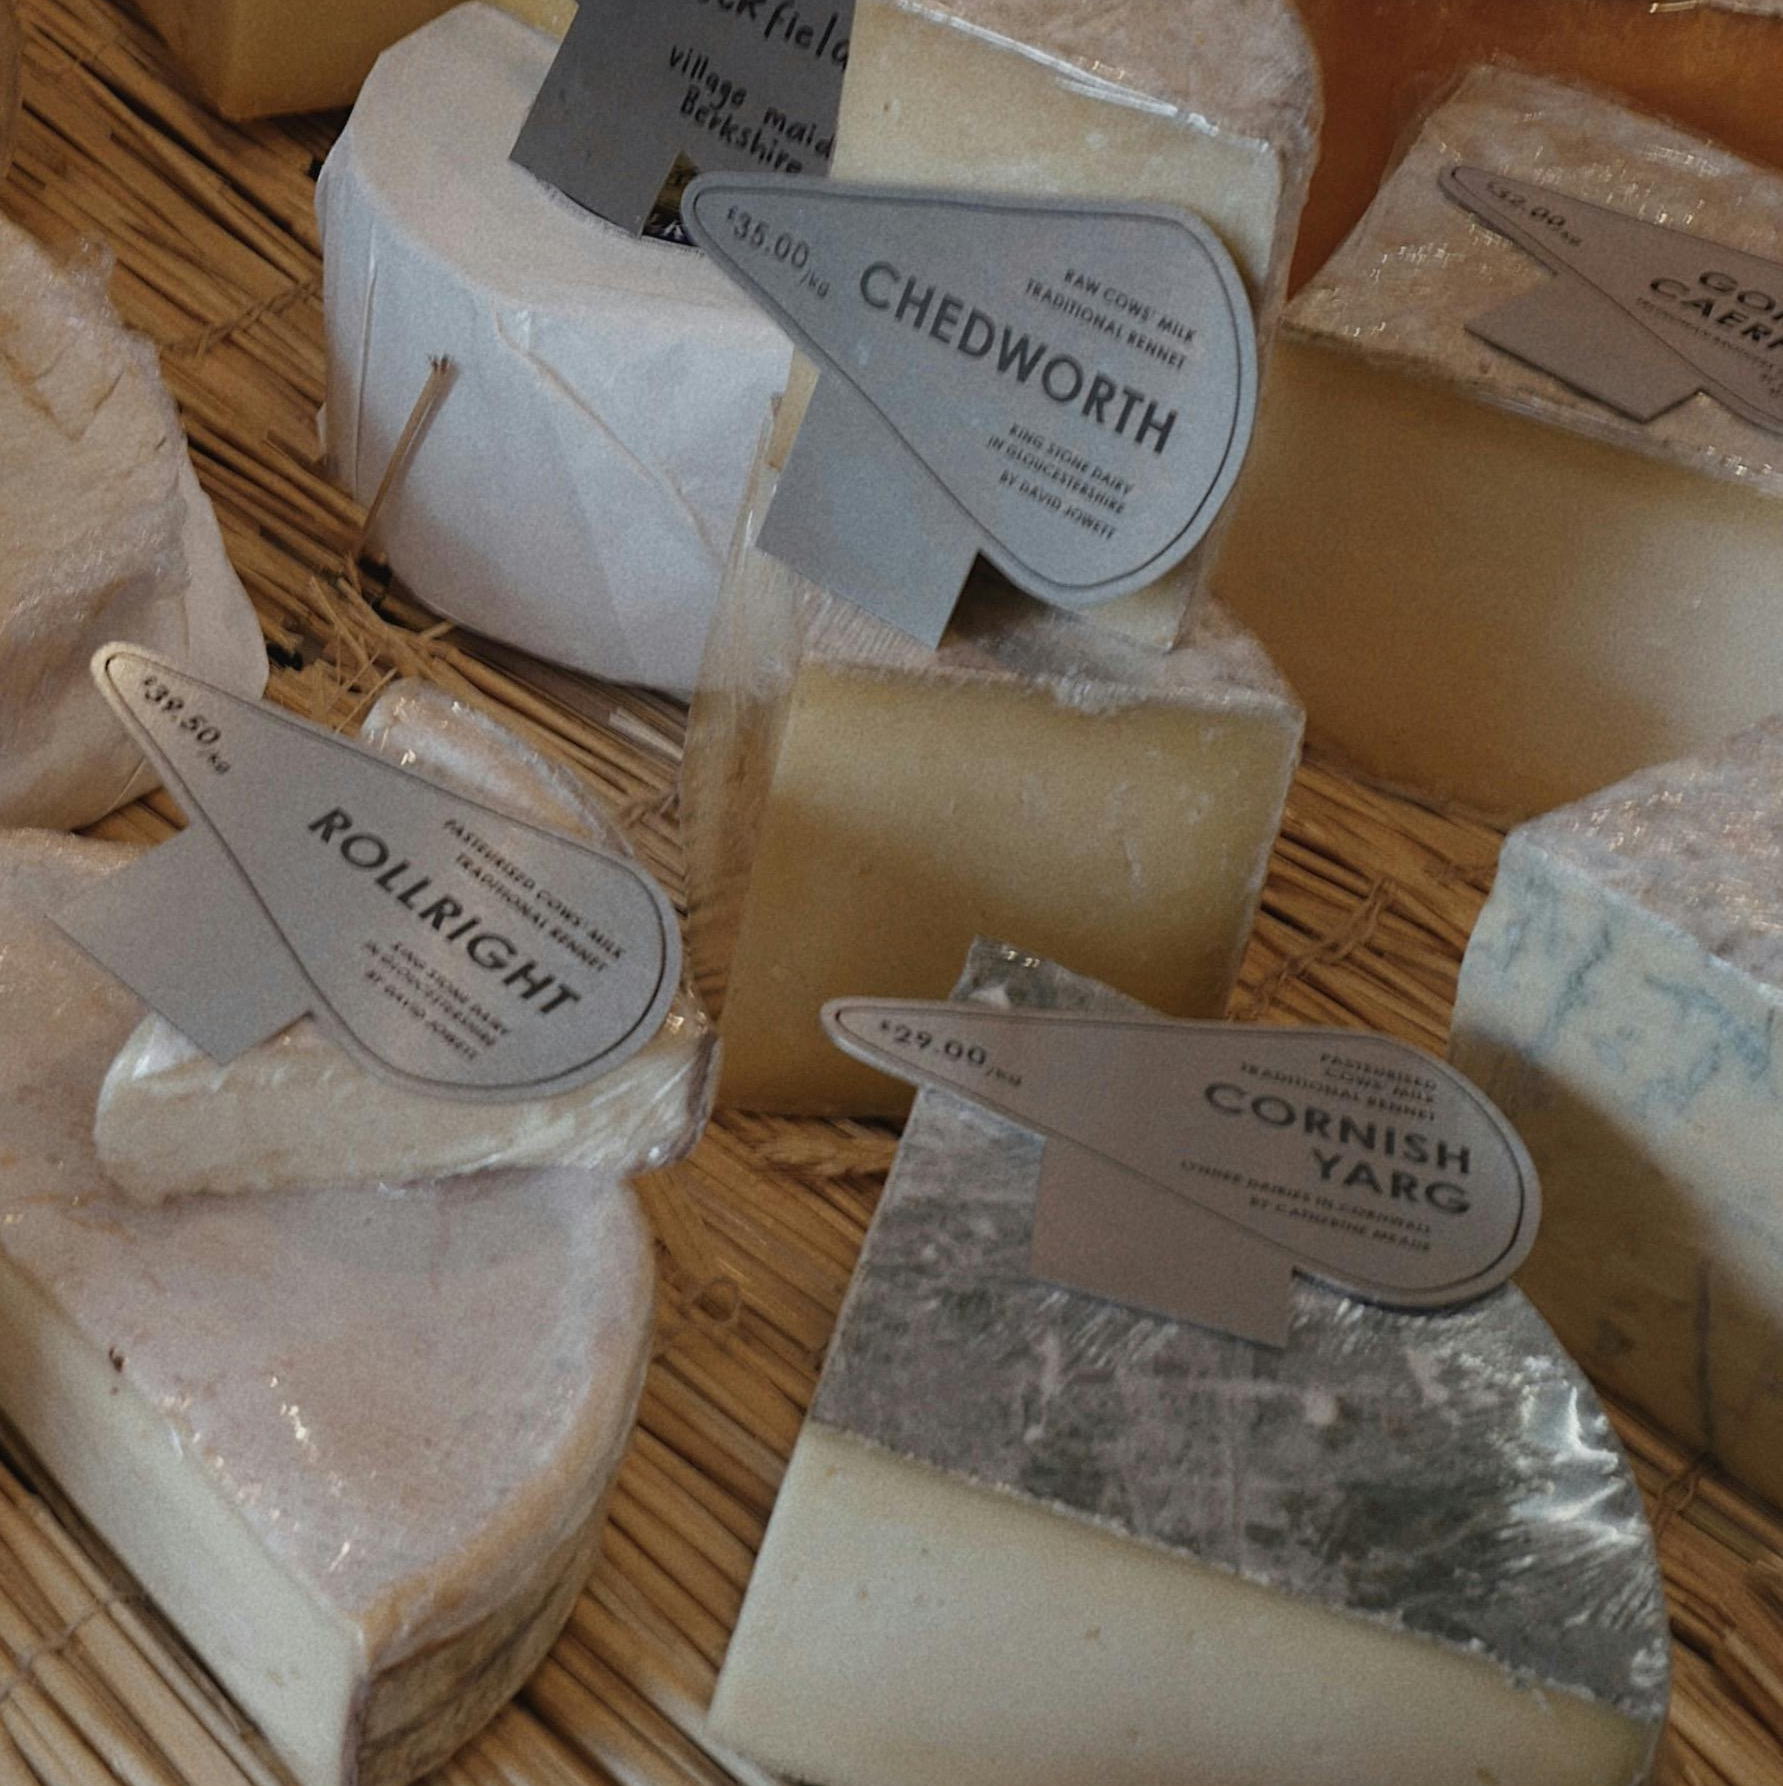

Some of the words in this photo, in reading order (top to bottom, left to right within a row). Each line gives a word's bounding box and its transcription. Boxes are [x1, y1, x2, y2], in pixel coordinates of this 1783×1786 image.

[668, 44, 748, 111] village
[763, 106, 836, 161] maid
[678, 83, 804, 175] Berkshire
[1021, 276, 1127, 341] TRADITIONAL
[1123, 328, 1187, 370] RENNET
[1061, 266, 1103, 297] RAW
[1155, 313, 1197, 344] MILK
[1697, 270, 1783, 323] GO
[859, 260, 1179, 455] CHEDWORTH
[1016, 478, 1064, 512] DAVID
[1087, 464, 1135, 497] DAIRY
[307, 805, 582, 1018] ROLLRIGHT
[1203, 1081, 1472, 1177] CORNISH
[1311, 1149, 1472, 1216] YARG
